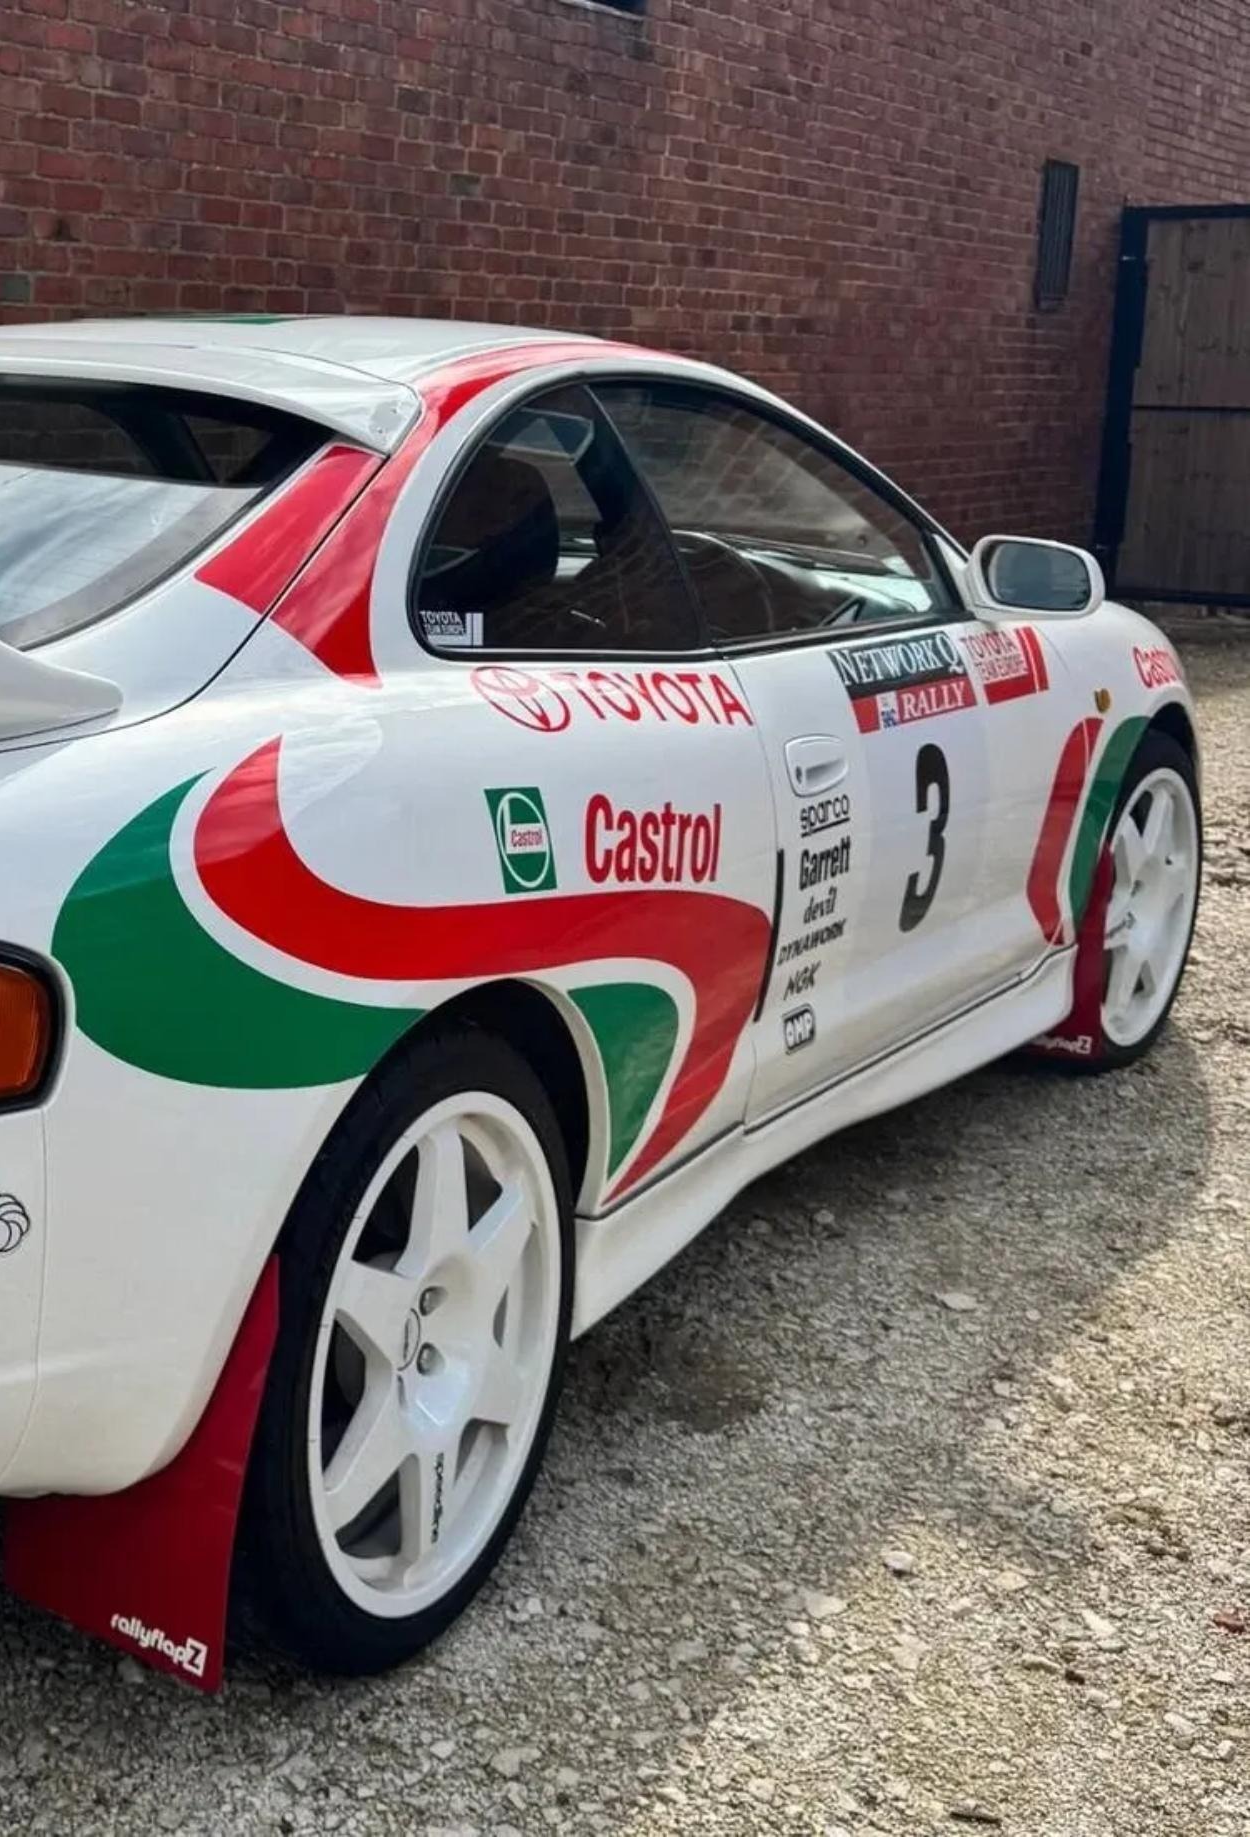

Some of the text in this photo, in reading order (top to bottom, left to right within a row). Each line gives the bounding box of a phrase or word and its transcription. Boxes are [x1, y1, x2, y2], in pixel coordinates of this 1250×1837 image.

[829, 633, 964, 686] NETWORK Q
[960, 630, 1017, 659] TOYOTA
[549, 671, 753, 726] TOYOTA
[902, 681, 966, 719] RALLY
[800, 794, 850, 832] sparco
[511, 829, 543, 848] Castrol
[585, 793, 721, 883] Castrol
[899, 743, 950, 932] 3
[799, 835, 851, 891] Garrett
[783, 960, 821, 1000] NGK
